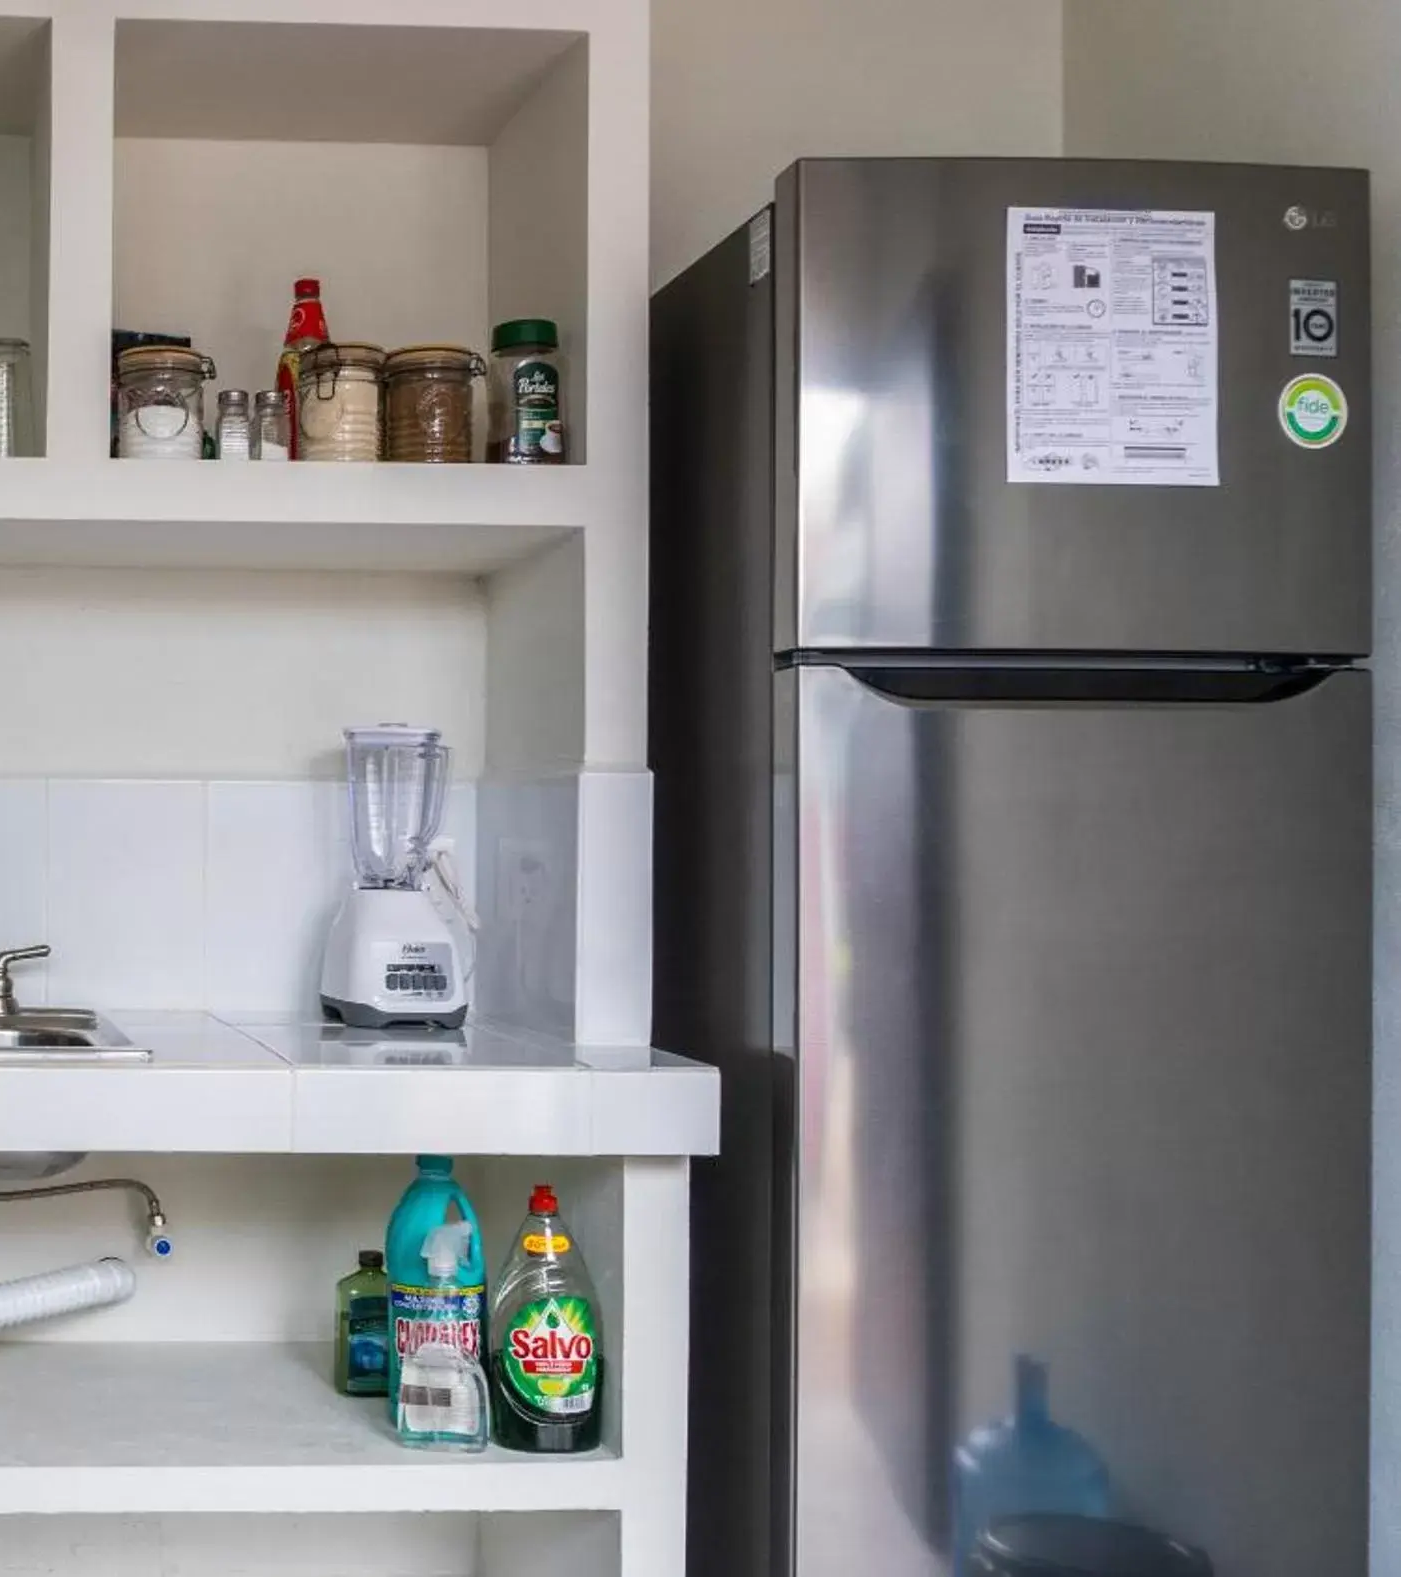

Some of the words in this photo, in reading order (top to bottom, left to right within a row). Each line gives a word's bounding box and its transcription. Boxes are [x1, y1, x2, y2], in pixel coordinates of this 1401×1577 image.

[1294, 308, 1333, 341] 10
[1299, 396, 1329, 413] fide
[511, 1329, 592, 1359] Salvo
